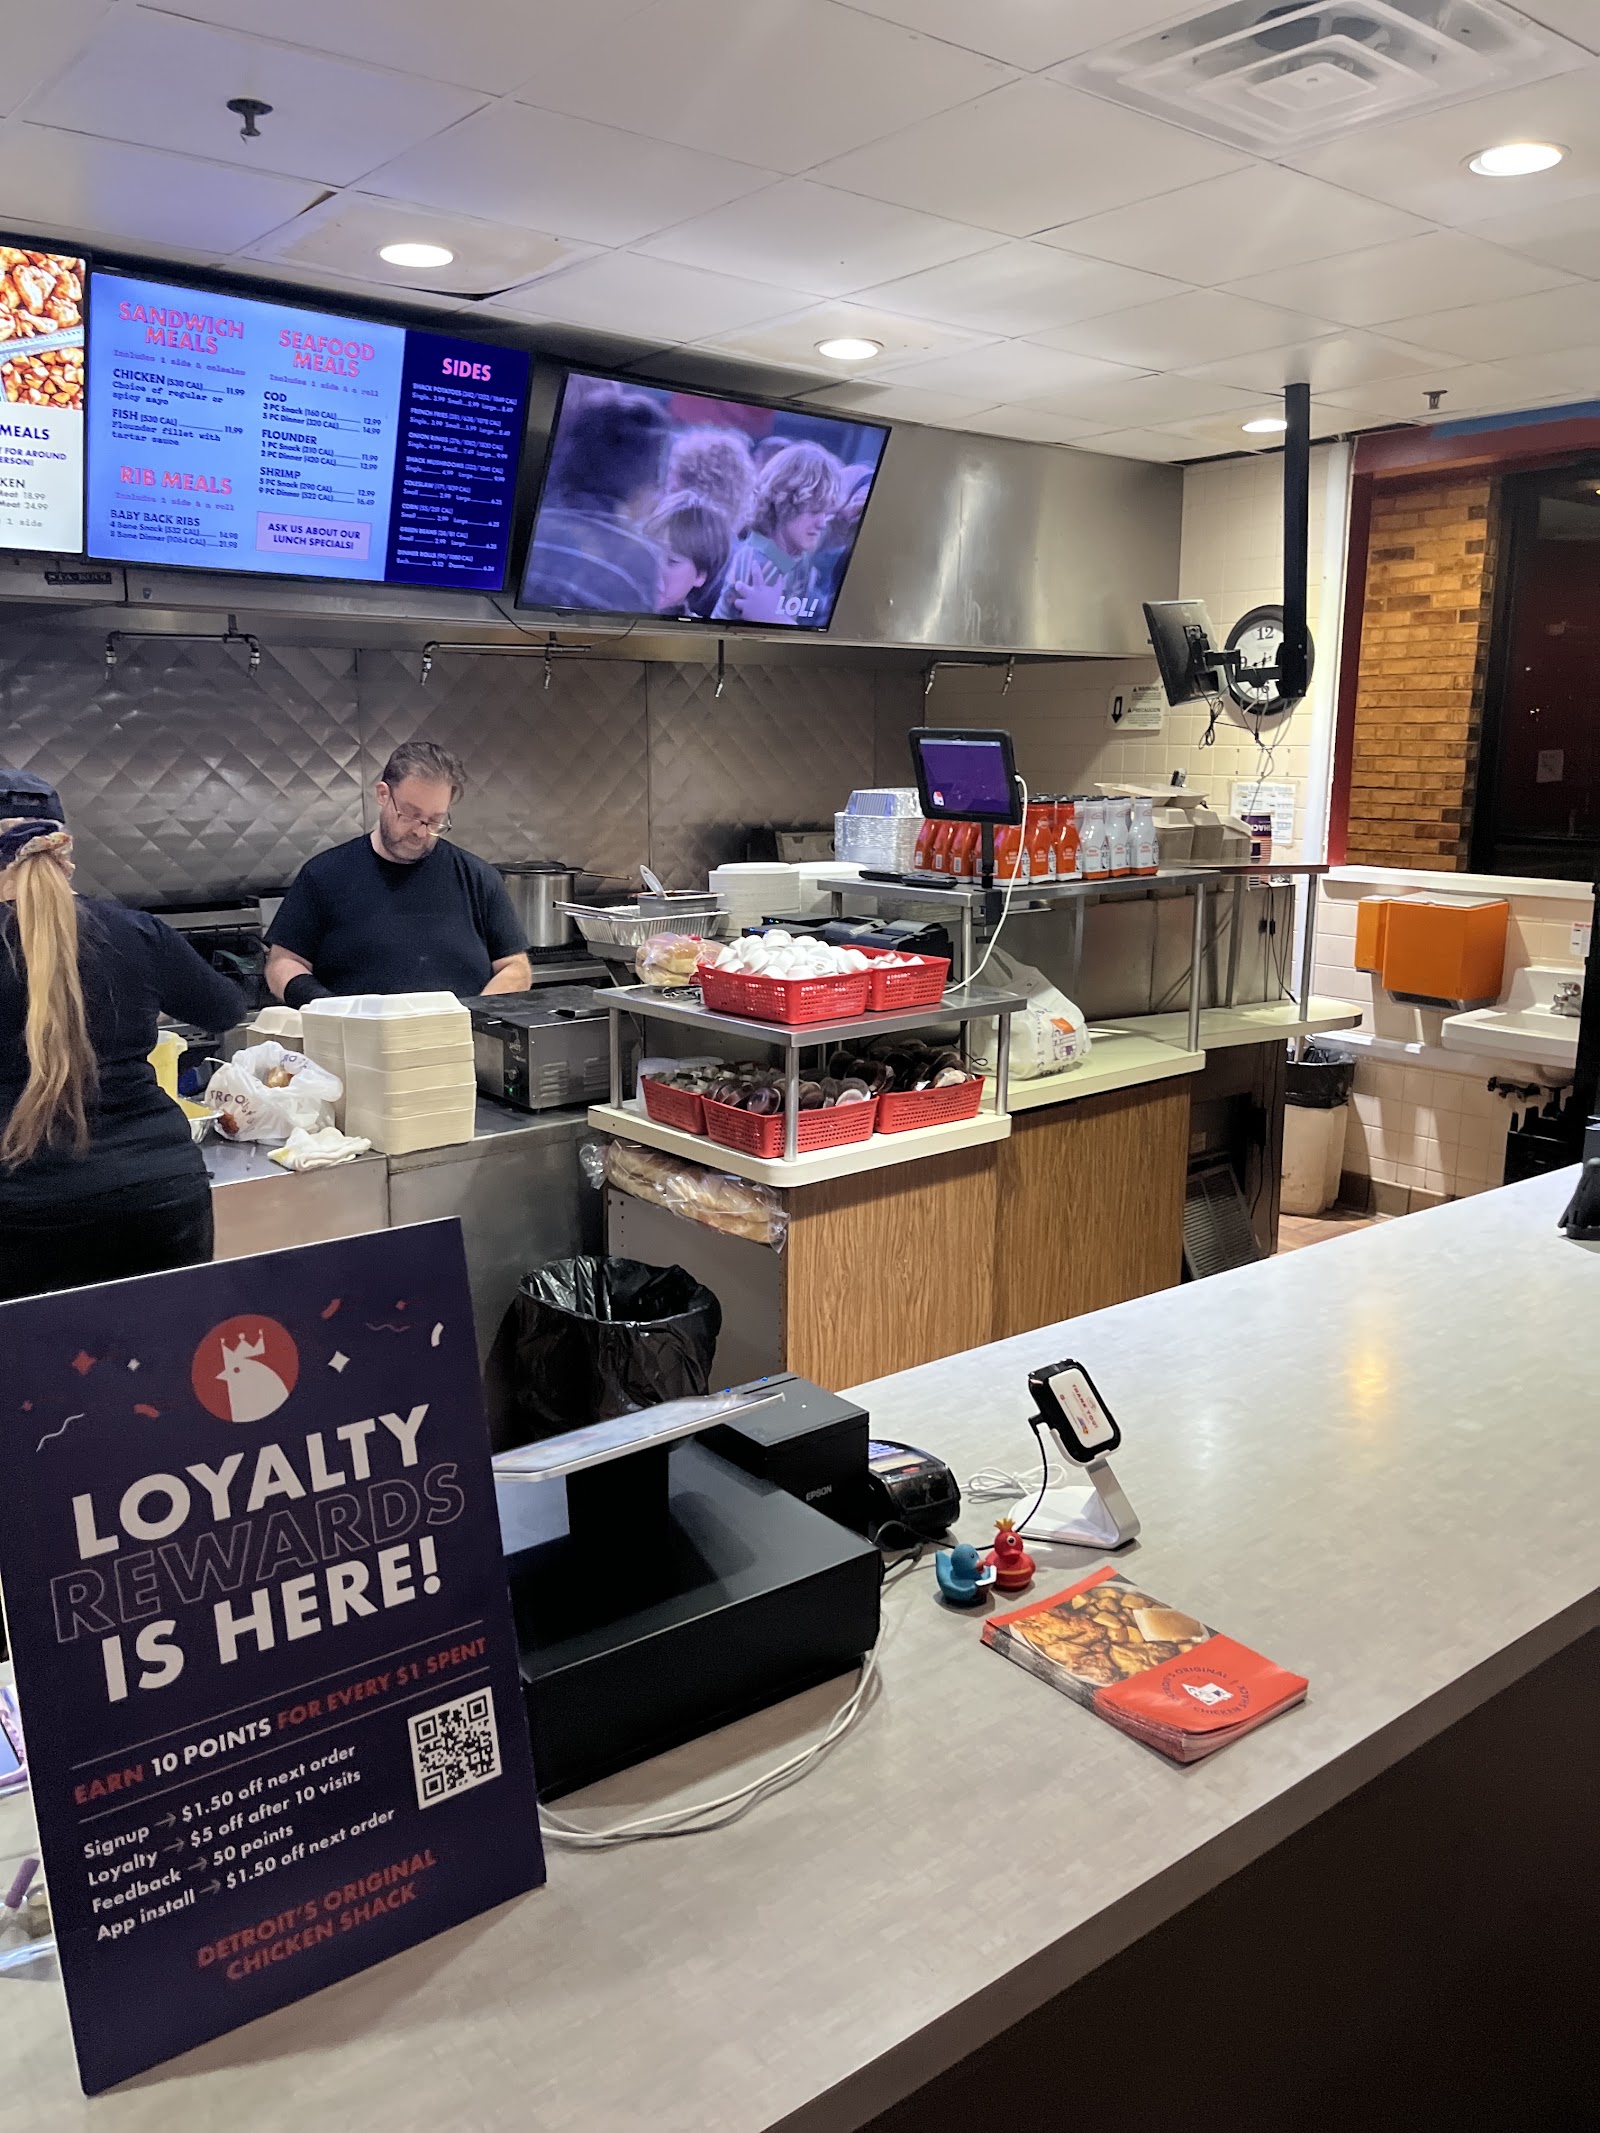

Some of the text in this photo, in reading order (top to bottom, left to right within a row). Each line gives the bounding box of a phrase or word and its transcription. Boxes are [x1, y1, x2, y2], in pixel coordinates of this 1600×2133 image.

[119, 301, 244, 339] SANDWICH
[145, 326, 218, 354] MEALS
[279, 329, 375, 361] SEAFOOD
[293, 351, 359, 377] MEALS
[442, 358, 491, 381] SIDES
[112, 381, 146, 392] Choice
[168, 390, 208, 401] regular
[113, 368, 165, 384] CHICKEN
[226, 387, 245, 396] 11.99
[112, 392, 169, 405] spicy mayo
[264, 391, 287, 402] COD
[112, 408, 138, 420] FISH
[225, 426, 243, 434] 11.99
[269, 413, 279, 421] PC
[281, 415, 305, 424] Dinner
[363, 426, 381, 434] 14.99
[270, 403, 280, 411] PC
[281, 406, 303, 415] Snack
[363, 418, 381, 426] 12.99
[0, 424, 49, 440] MEALS
[112, 421, 221, 442] Flounder fillet with
[112, 431, 179, 446] tartar sauce
[262, 429, 317, 445] FLOUNDER
[5, 447, 67, 460] FOR AROUND
[267, 441, 277, 449] PC
[279, 443, 300, 452] Snack
[279, 452, 302, 461] Dinner
[0, 456, 34, 466] ERSON!
[120, 466, 232, 495] RIB MEALS
[260, 466, 301, 479] SHRIMP
[277, 480, 298, 488] Snack
[19, 519, 42, 527] side
[110, 510, 200, 526] BABY BACK RIBS
[140, 524, 163, 533] Snack
[140, 532, 165, 542] Dinner
[268, 523, 360, 539] ASK US ABOUT OUR
[273, 535, 354, 549] LUNCH SPECIALS!
[775, 596, 819, 617] LOL!
[1257, 626, 1274, 640] 12
[1072, 1384, 1087, 1408] THANK
[72, 1404, 429, 1560] LOYALTY
[806, 1484, 832, 1501] EPSON
[50, 1463, 465, 1643] REWARDS
[102, 1535, 441, 1702] IS HERE!
[1175, 1667, 1227, 1678] ORIGINAL
[1194, 1706, 1242, 1715] CHICKEN
[74, 1764, 144, 1806] EARN
[151, 1753, 179, 1776] 10
[184, 1717, 272, 1765] POINTS
[277, 1700, 322, 1730] FOR
[327, 1673, 391, 1711] EVERY
[426, 1637, 487, 1674] SPENT
[84, 1745, 356, 1859] Signup $1.50 off next order
[88, 1771, 361, 1886] Loyalty $5 off after 10 visits
[92, 1825, 294, 1913] Feedback 50 points
[97, 1809, 395, 1941] App install $1.50 off next order
[198, 1849, 437, 1969] DETROIT'S ORIGINAL
[226, 1883, 416, 1981] CHICKEN SHACK
